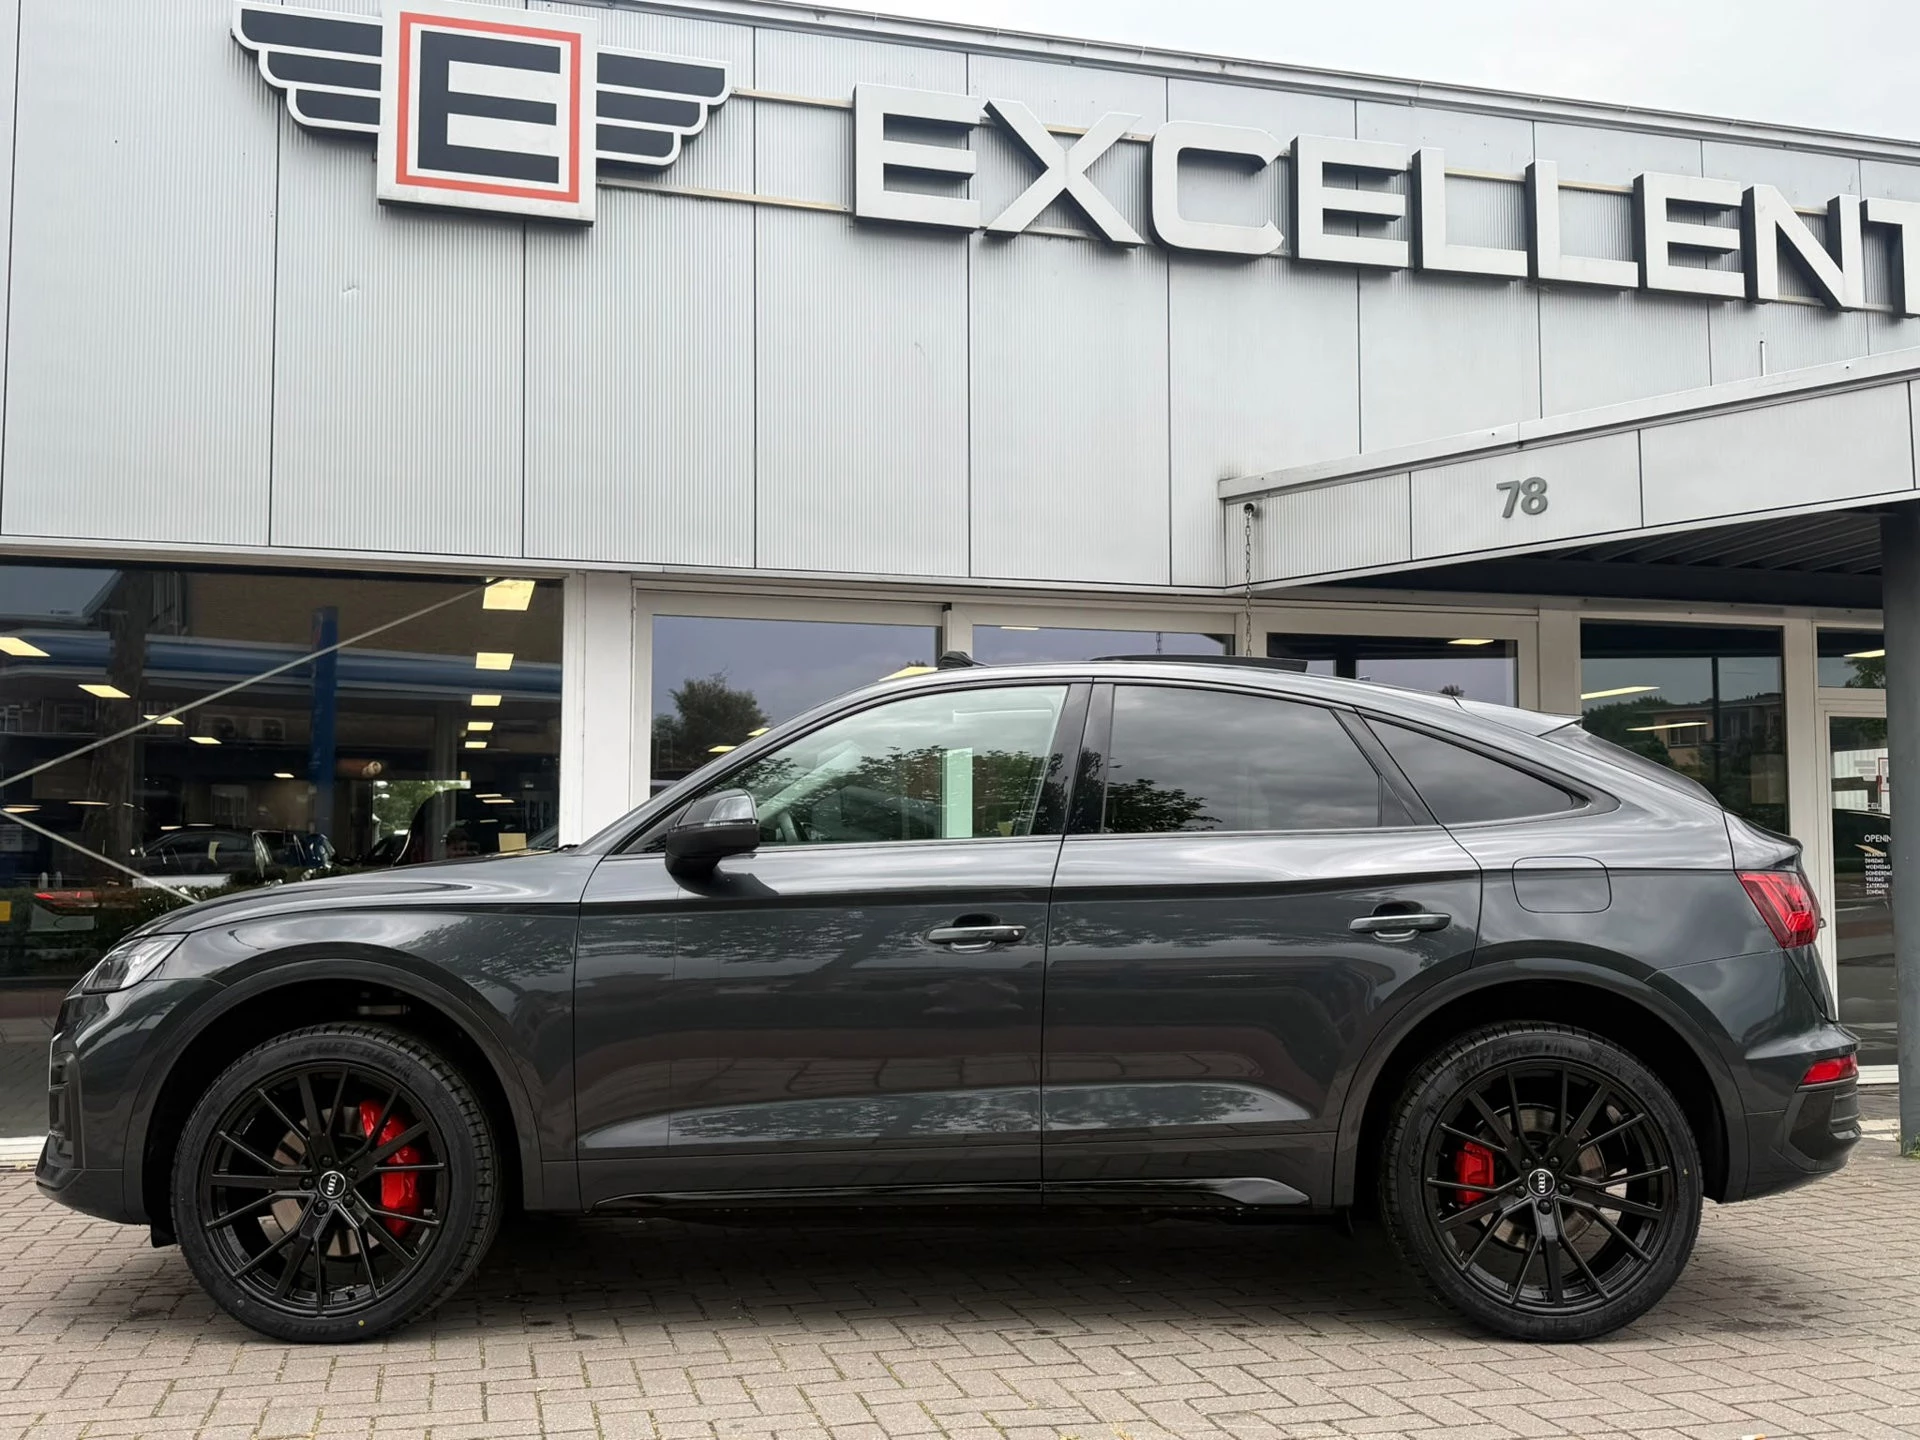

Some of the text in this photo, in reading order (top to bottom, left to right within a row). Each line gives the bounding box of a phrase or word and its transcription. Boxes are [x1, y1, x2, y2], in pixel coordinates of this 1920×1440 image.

[417, 30, 561, 184] E
[853, 83, 1920, 318] EXCELLENT
[1496, 476, 1548, 519] 78
